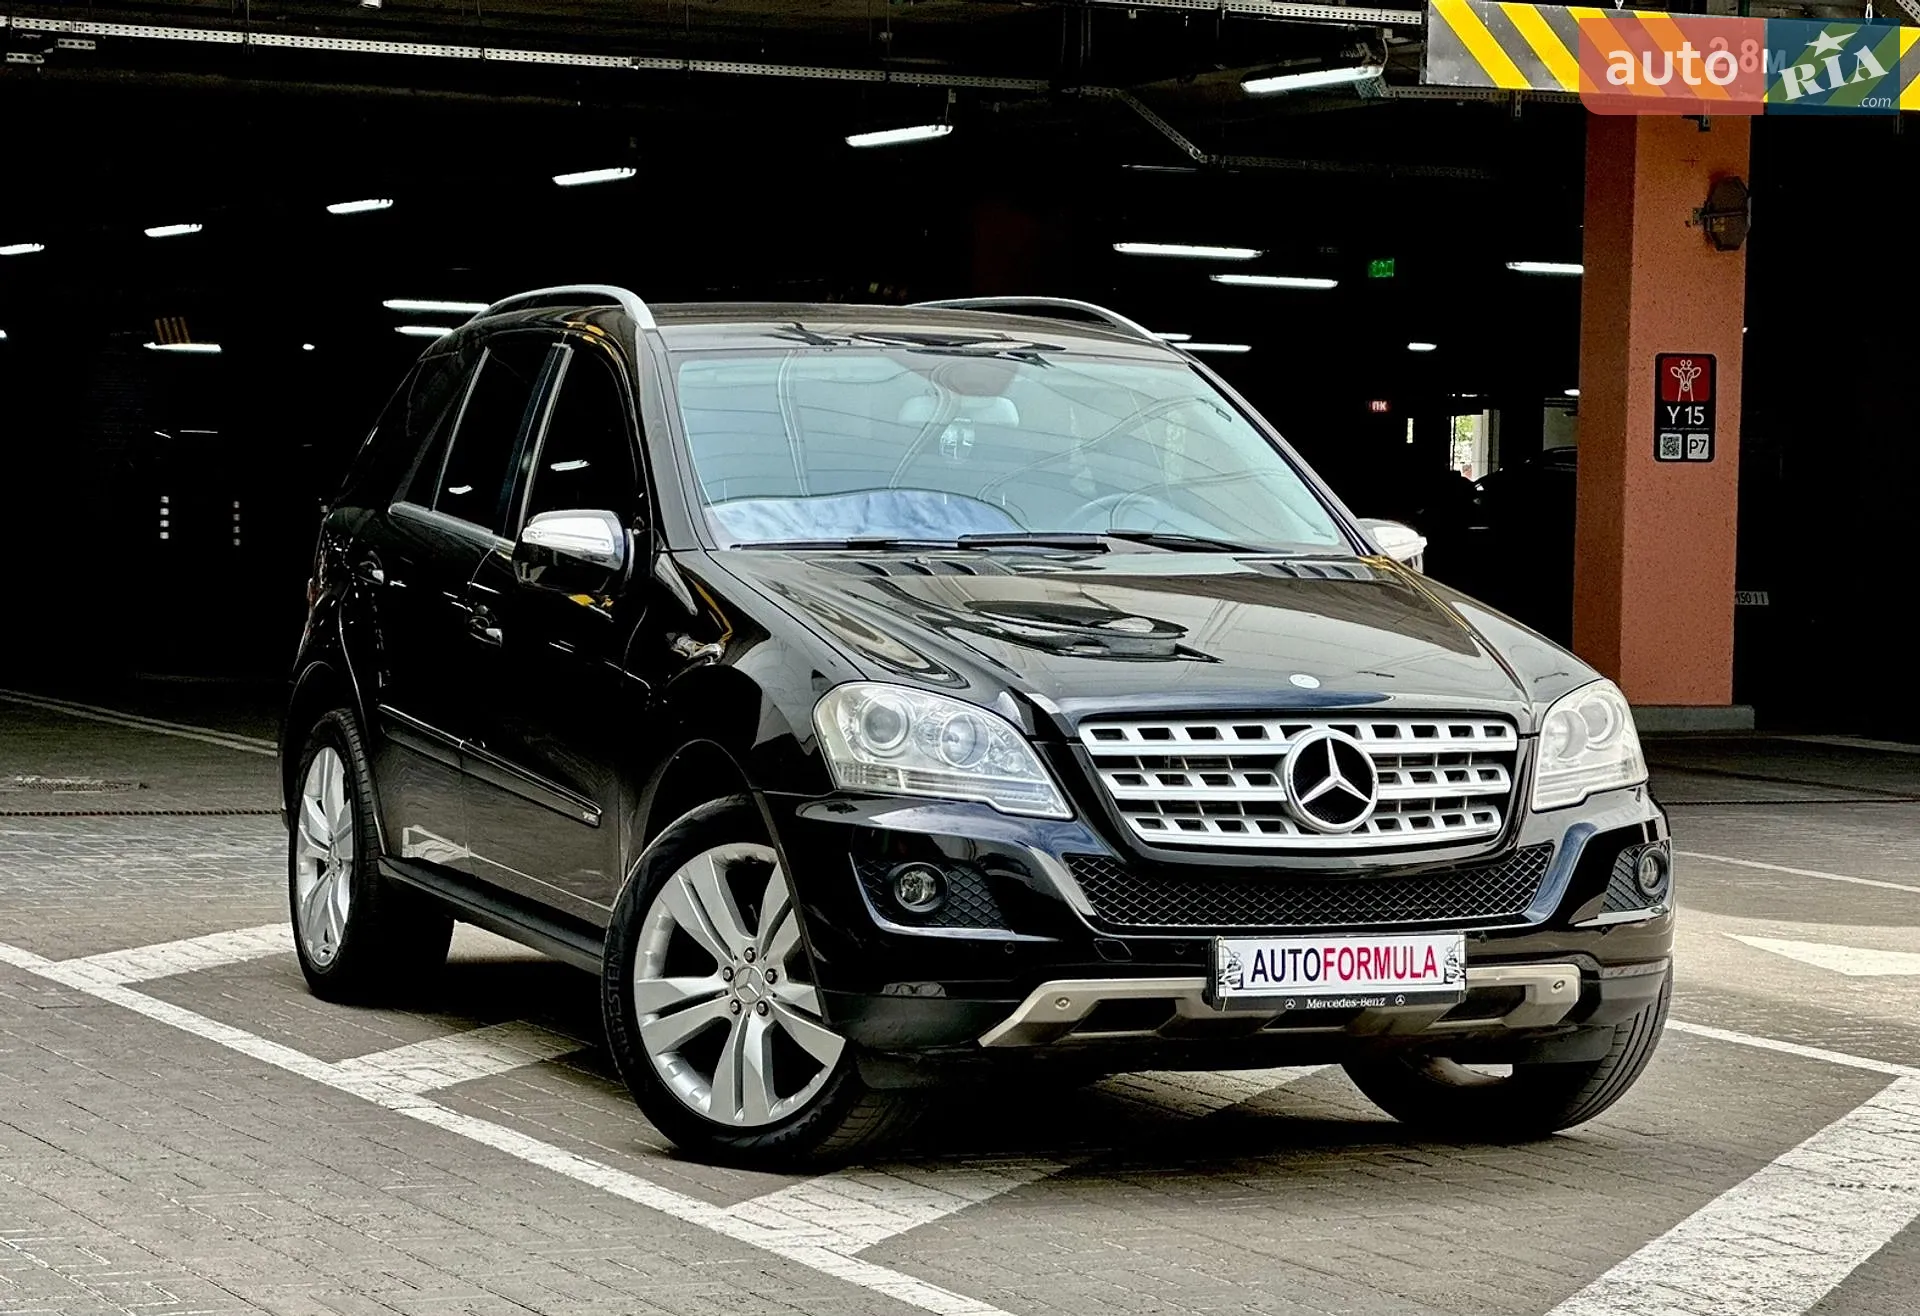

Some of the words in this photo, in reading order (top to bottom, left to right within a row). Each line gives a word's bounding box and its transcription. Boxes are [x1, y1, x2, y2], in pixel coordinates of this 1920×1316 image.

[1666, 405, 1681, 425] Y
[1684, 405, 1705, 426] 15
[1689, 438, 1707, 454] P7
[1250, 945, 1438, 983] AUTOFORMULA
[1306, 997, 1386, 1010] Mercedes-Benz
